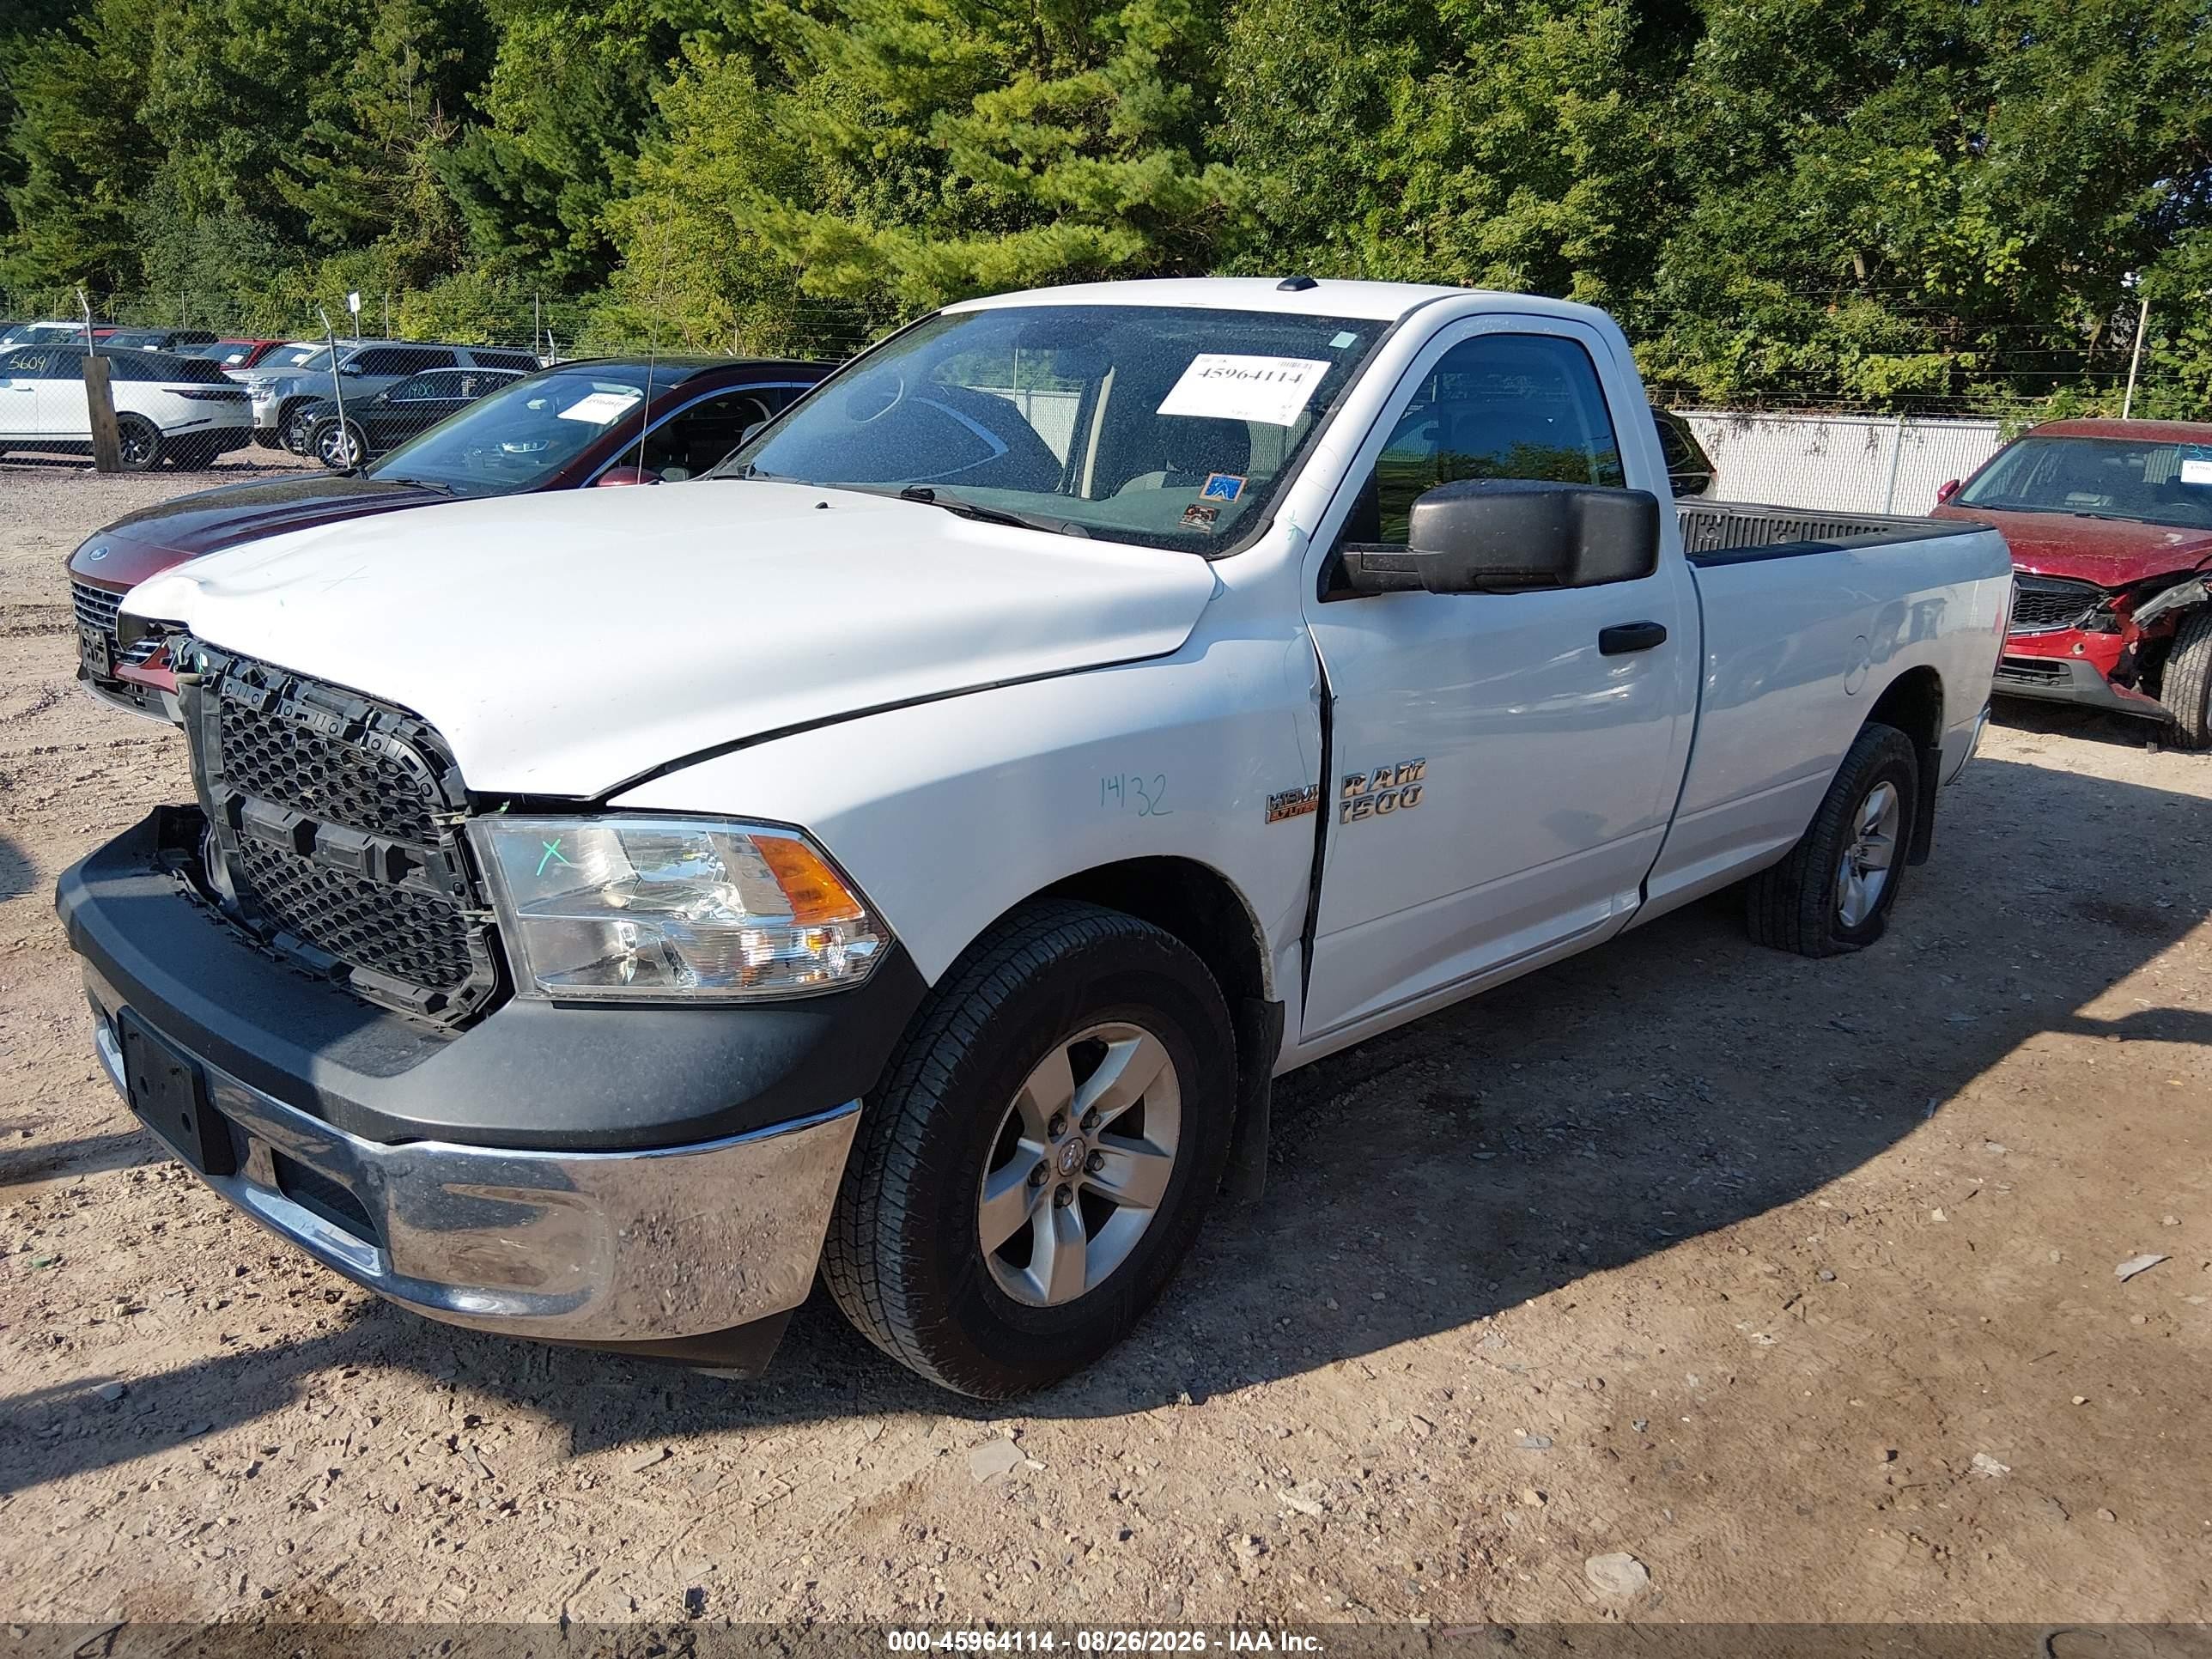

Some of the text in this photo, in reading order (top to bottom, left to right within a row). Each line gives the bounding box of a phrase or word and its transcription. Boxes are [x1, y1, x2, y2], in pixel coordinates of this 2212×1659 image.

[7, 354, 46, 372] 5609
[1197, 367, 1304, 384] 45964114
[1340, 757, 1426, 799] RAM
[1339, 782, 1424, 825] 1500
